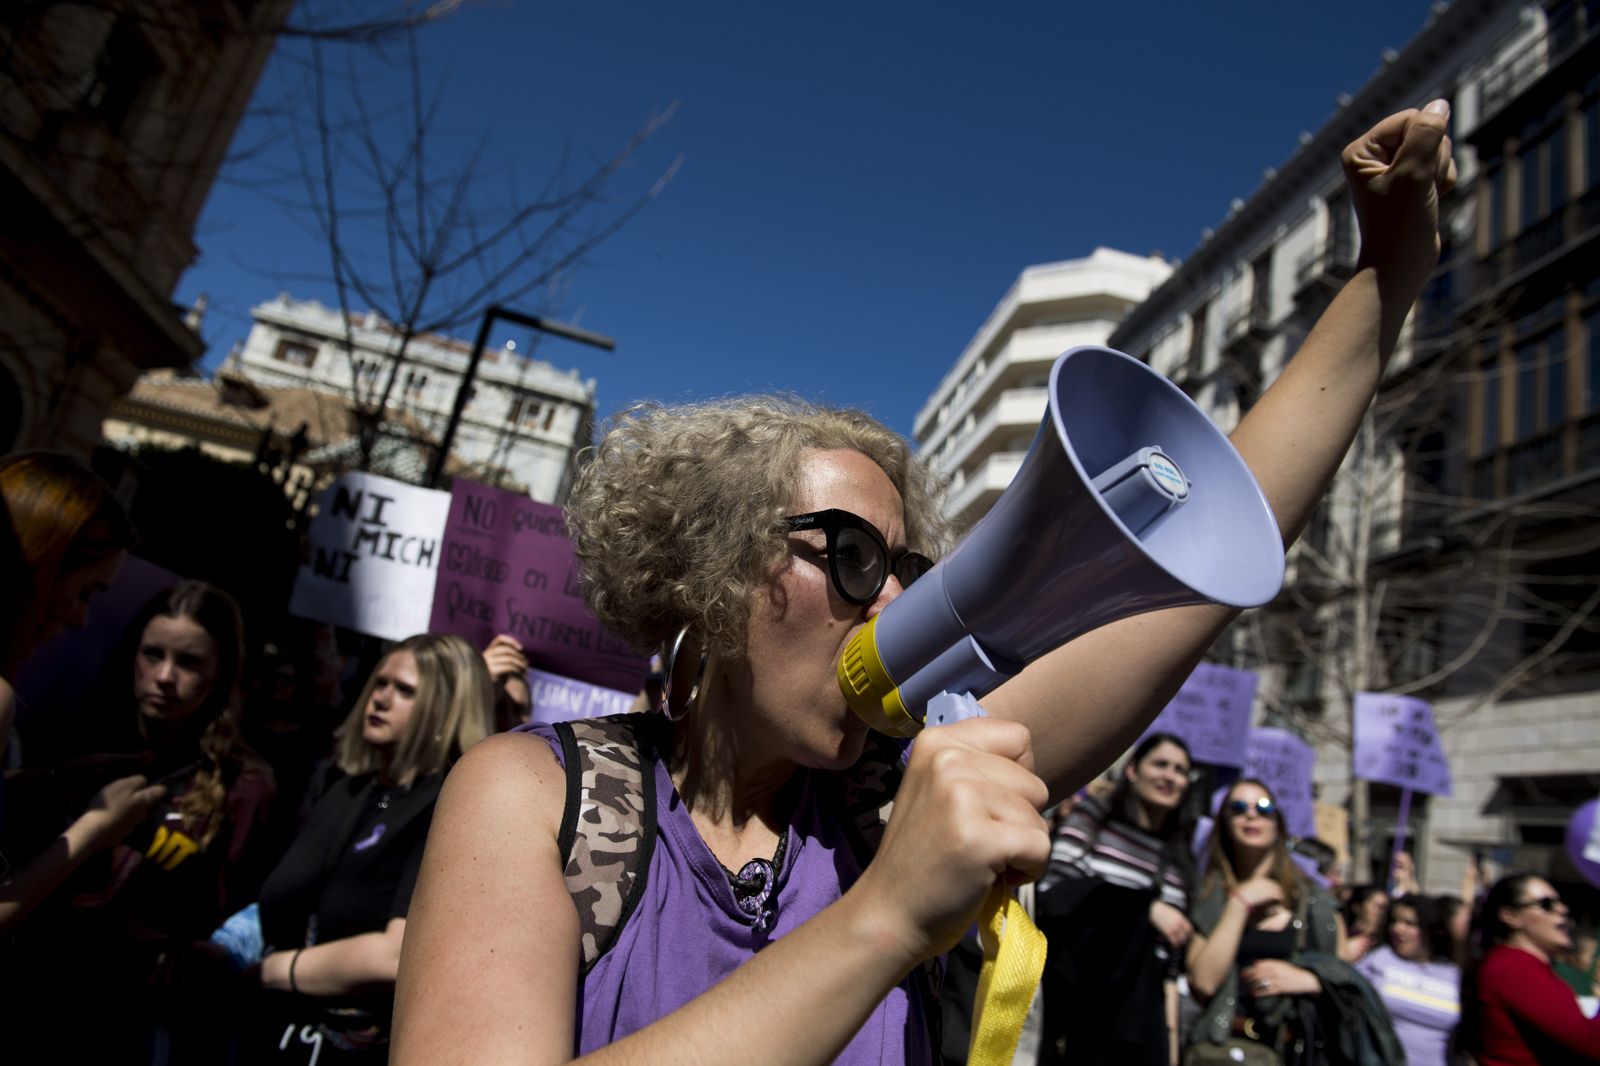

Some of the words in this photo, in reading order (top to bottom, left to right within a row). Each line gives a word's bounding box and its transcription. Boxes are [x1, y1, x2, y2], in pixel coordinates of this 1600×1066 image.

[330, 486, 395, 527] NI
[461, 494, 497, 530] NO
[313, 547, 361, 583] NI
